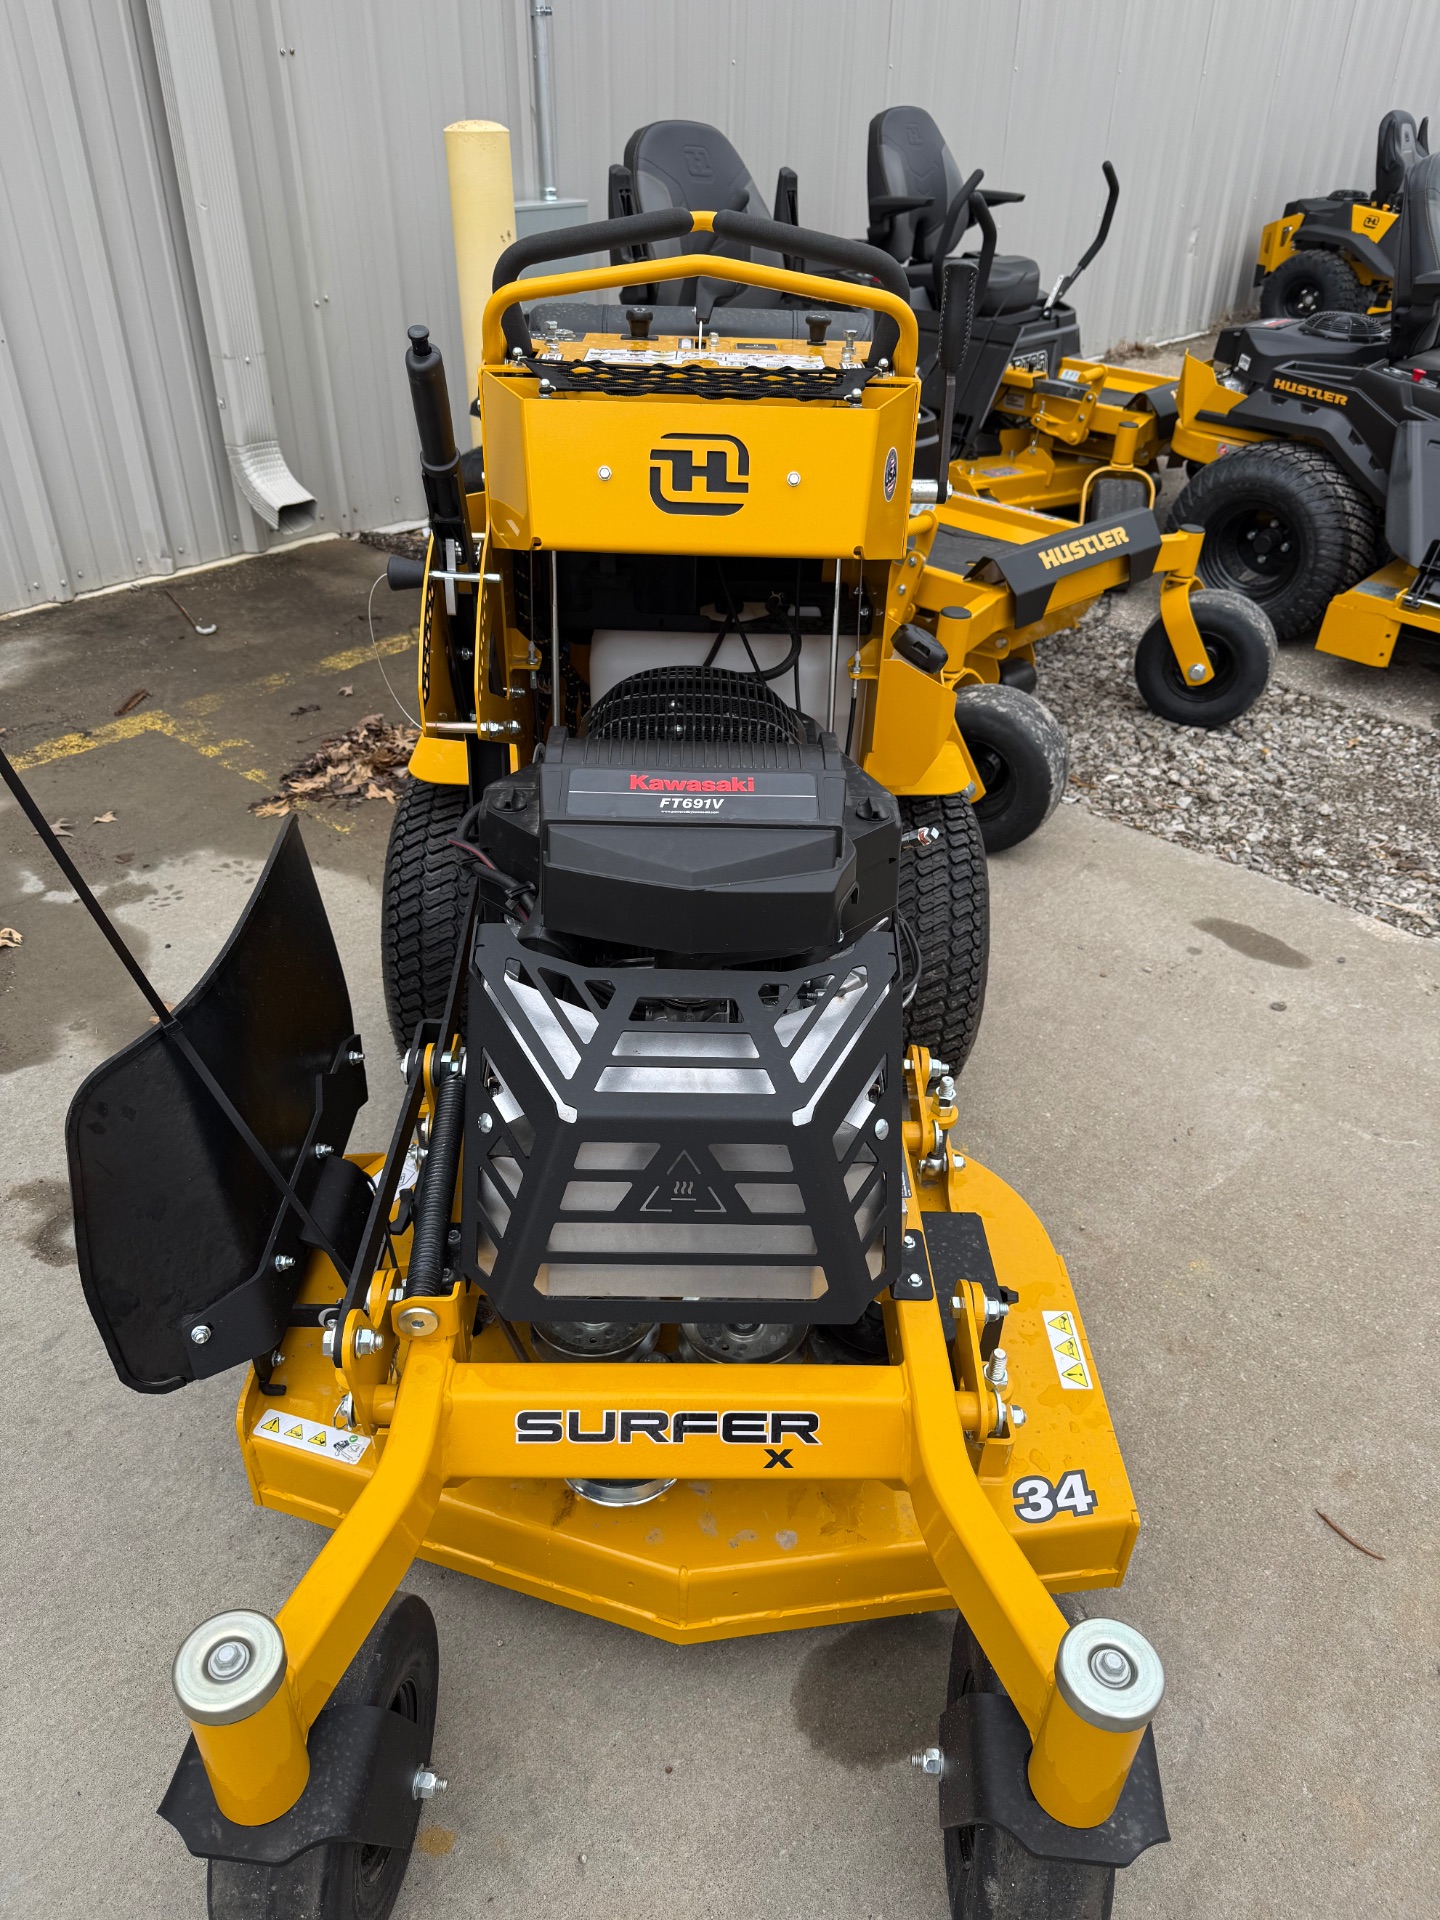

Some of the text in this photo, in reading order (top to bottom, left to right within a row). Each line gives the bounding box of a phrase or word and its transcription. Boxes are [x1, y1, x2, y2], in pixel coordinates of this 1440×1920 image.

[1273, 378, 1348, 406] HUSTLER
[1038, 526, 1130, 570] HUSTLER
[629, 774, 755, 792] Kawasaki
[659, 797, 725, 809] FT691V
[515, 1410, 822, 1445] SURFER
[763, 1448, 794, 1469] X
[1013, 1470, 1097, 1523] 34
